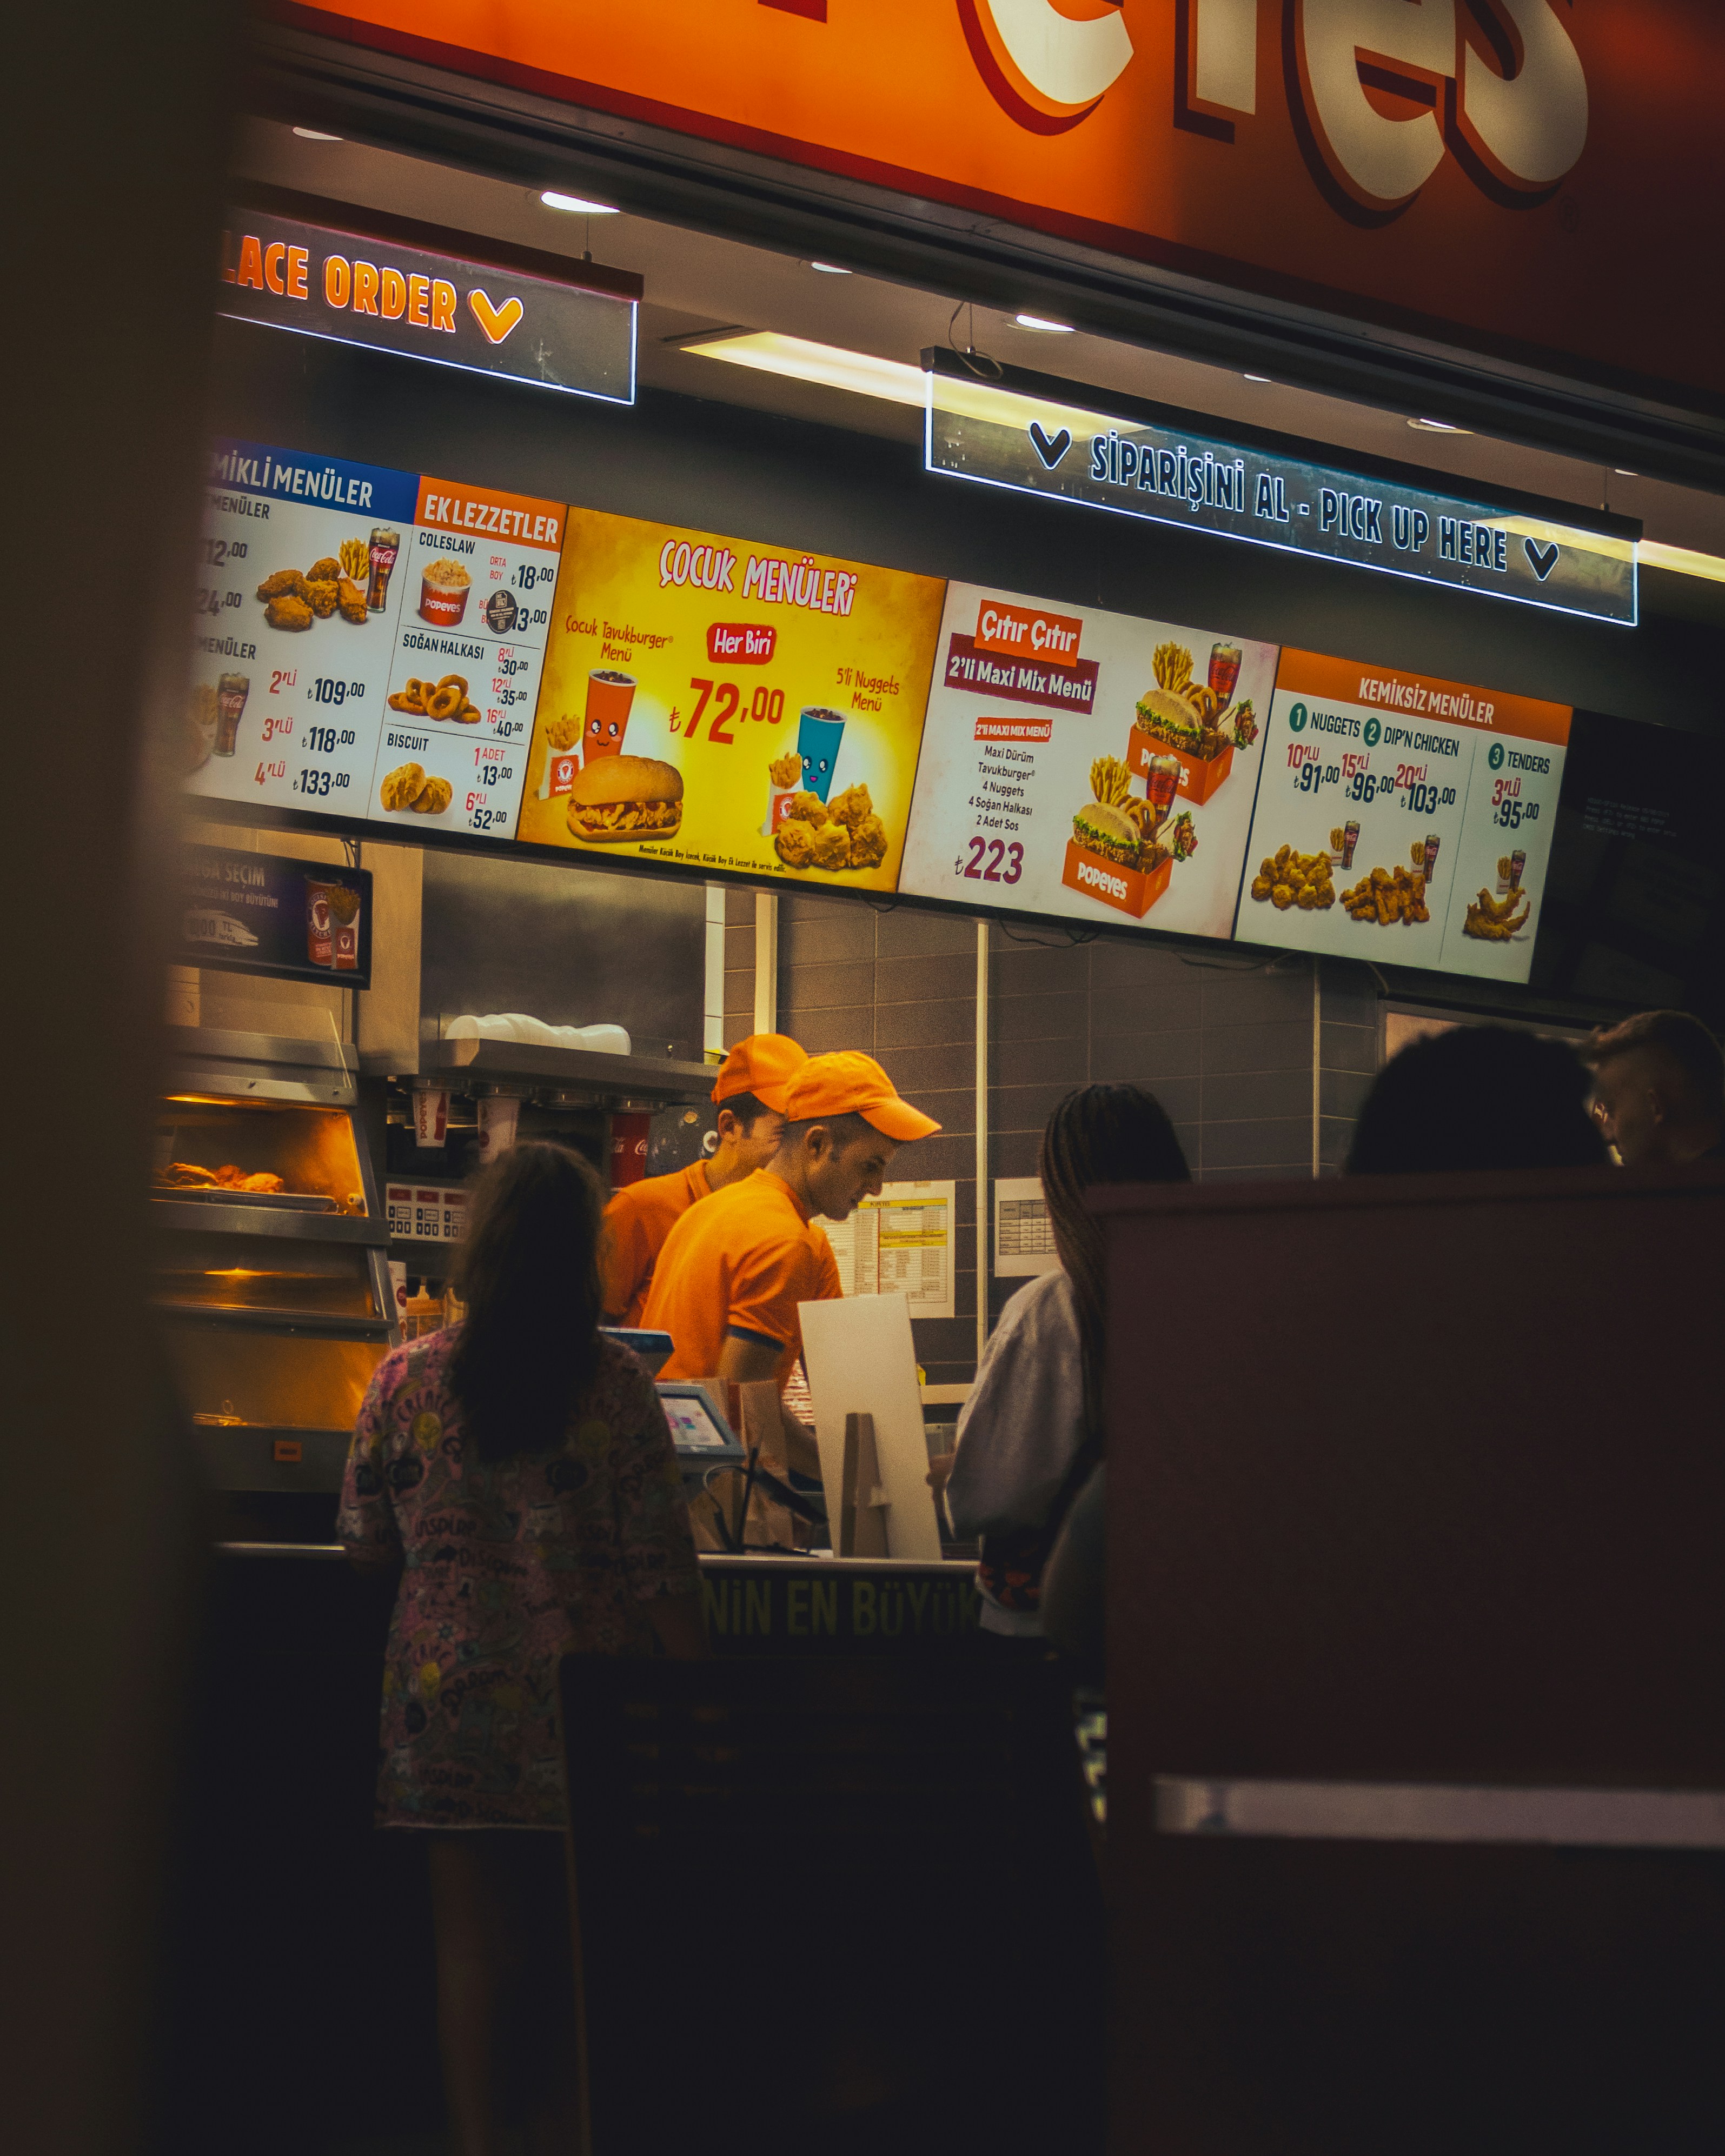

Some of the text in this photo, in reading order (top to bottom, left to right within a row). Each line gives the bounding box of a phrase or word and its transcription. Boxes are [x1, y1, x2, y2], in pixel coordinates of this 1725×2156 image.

[325, 255, 457, 333] ORDER
[274, 464, 373, 509] MENÜLER
[424, 494, 558, 544] EK LEZZETLER
[1254, 474, 1290, 523] AL
[1318, 488, 1383, 545] PICK
[1391, 505, 1430, 553] UP
[1439, 515, 1508, 572] HERE
[419, 532, 475, 554] COLESLAW
[490, 556, 506, 567] ORTA
[490, 570, 503, 581] BOY
[566, 615, 598, 636] Çocuk
[981, 610, 1077, 652] Çıtır Çıtır
[403, 634, 484, 660] SOĞAN HALKASI
[600, 642, 632, 662] Menü
[714, 628, 772, 656] Her Biri
[854, 671, 900, 696] Nuggets
[977, 661, 1016, 687] Maxi
[1018, 668, 1047, 693] Mix
[1048, 674, 1092, 701] Menü
[852, 693, 882, 713] Menü
[1358, 677, 1494, 725] KEMİKSİZ MENÜLER
[387, 732, 429, 751] BISCUIT
[1026, 724, 1050, 737] MENÜ
[1311, 712, 1361, 737] NUGGETS
[1414, 733, 1460, 757] CHICKEN
[475, 747, 506, 766] 1 ADET
[984, 745, 1034, 763] Maxi Dürüm
[1508, 751, 1550, 774] TENDERS
[983, 781, 1024, 797] 4 Nuggets
[968, 796, 1032, 816] 4 Soğan Halkası
[976, 815, 1019, 831] 2 Adet Sos
[675, 850, 684, 860] Boy
[719, 856, 727, 866] Boy
[759, 862, 772, 871] servis
[787, 1579, 838, 1637] EN
